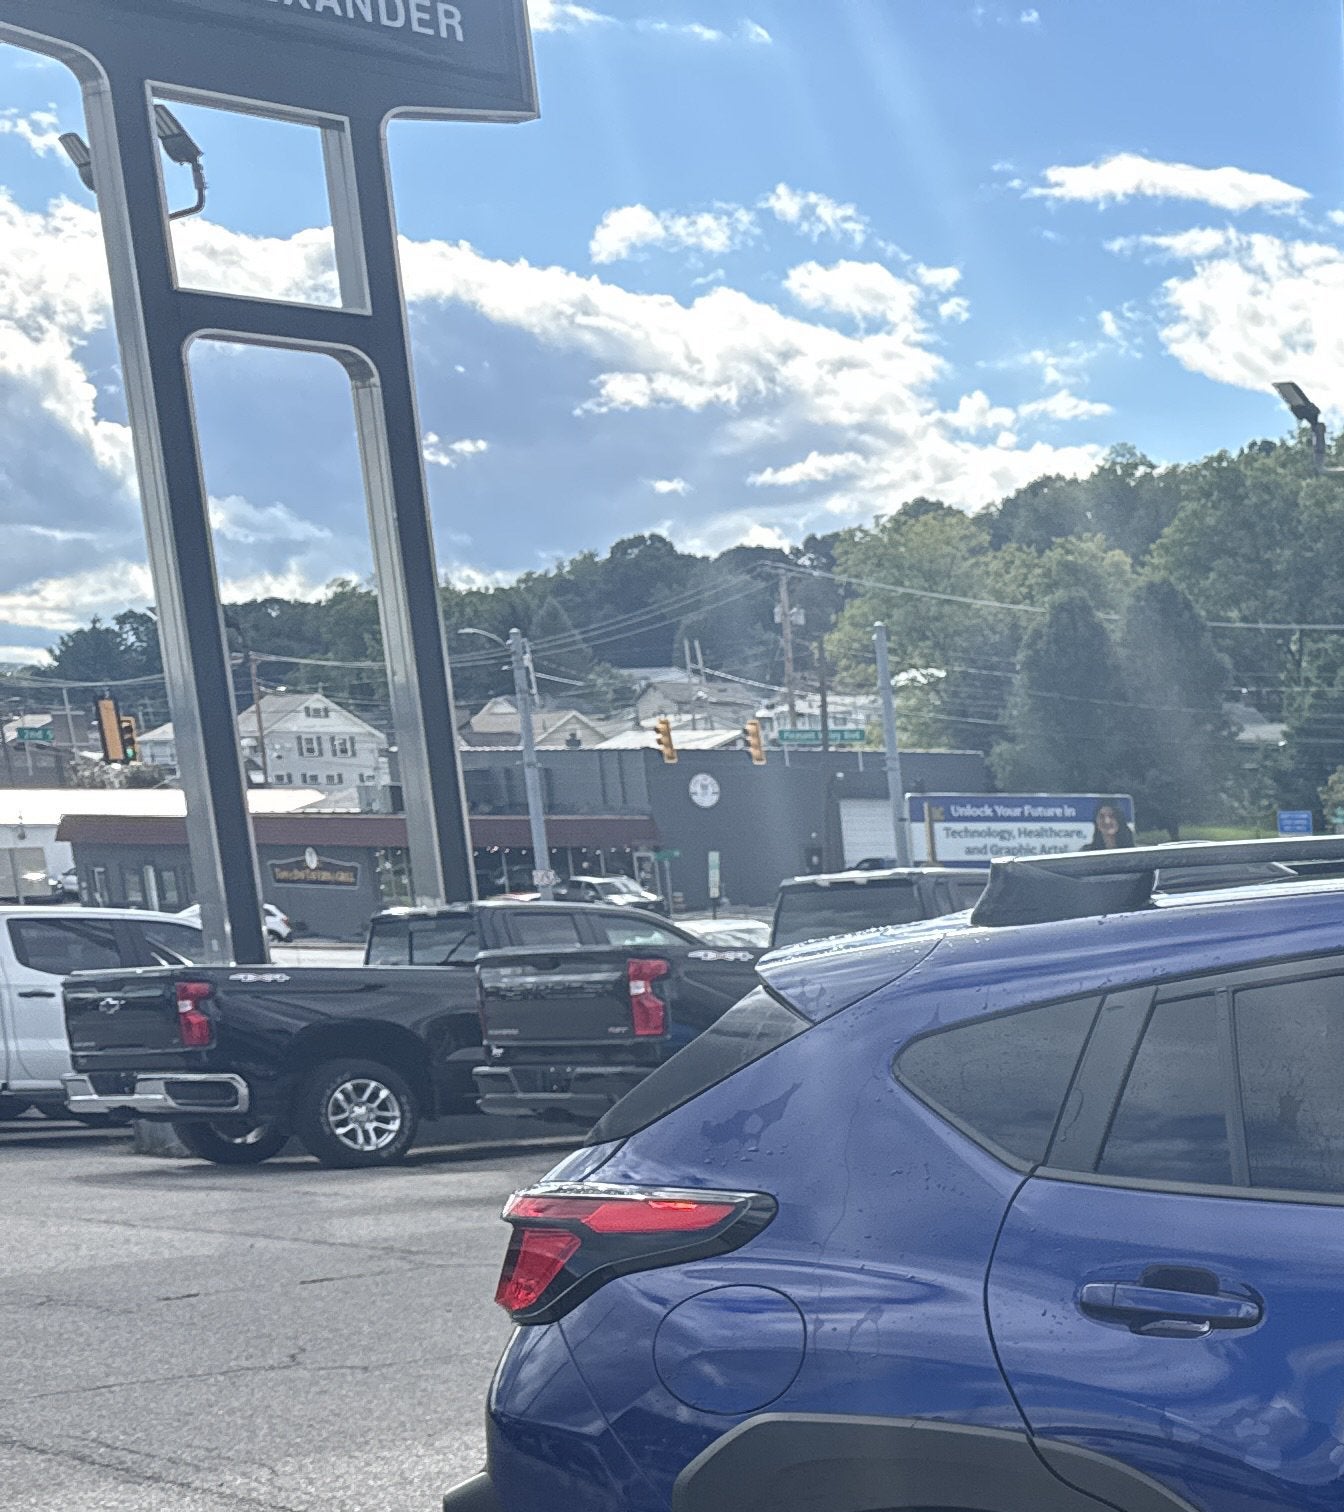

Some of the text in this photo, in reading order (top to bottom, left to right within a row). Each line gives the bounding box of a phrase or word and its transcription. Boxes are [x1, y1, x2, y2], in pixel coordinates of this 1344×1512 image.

[267, 0, 465, 42] NDER
[950, 804, 994, 817] Unlock
[995, 805, 1022, 817] Your
[1024, 804, 1063, 817] Future
[943, 826, 1087, 841] Technology, Healthcare,
[964, 844, 988, 856] and
[990, 844, 1037, 858] Graphic
